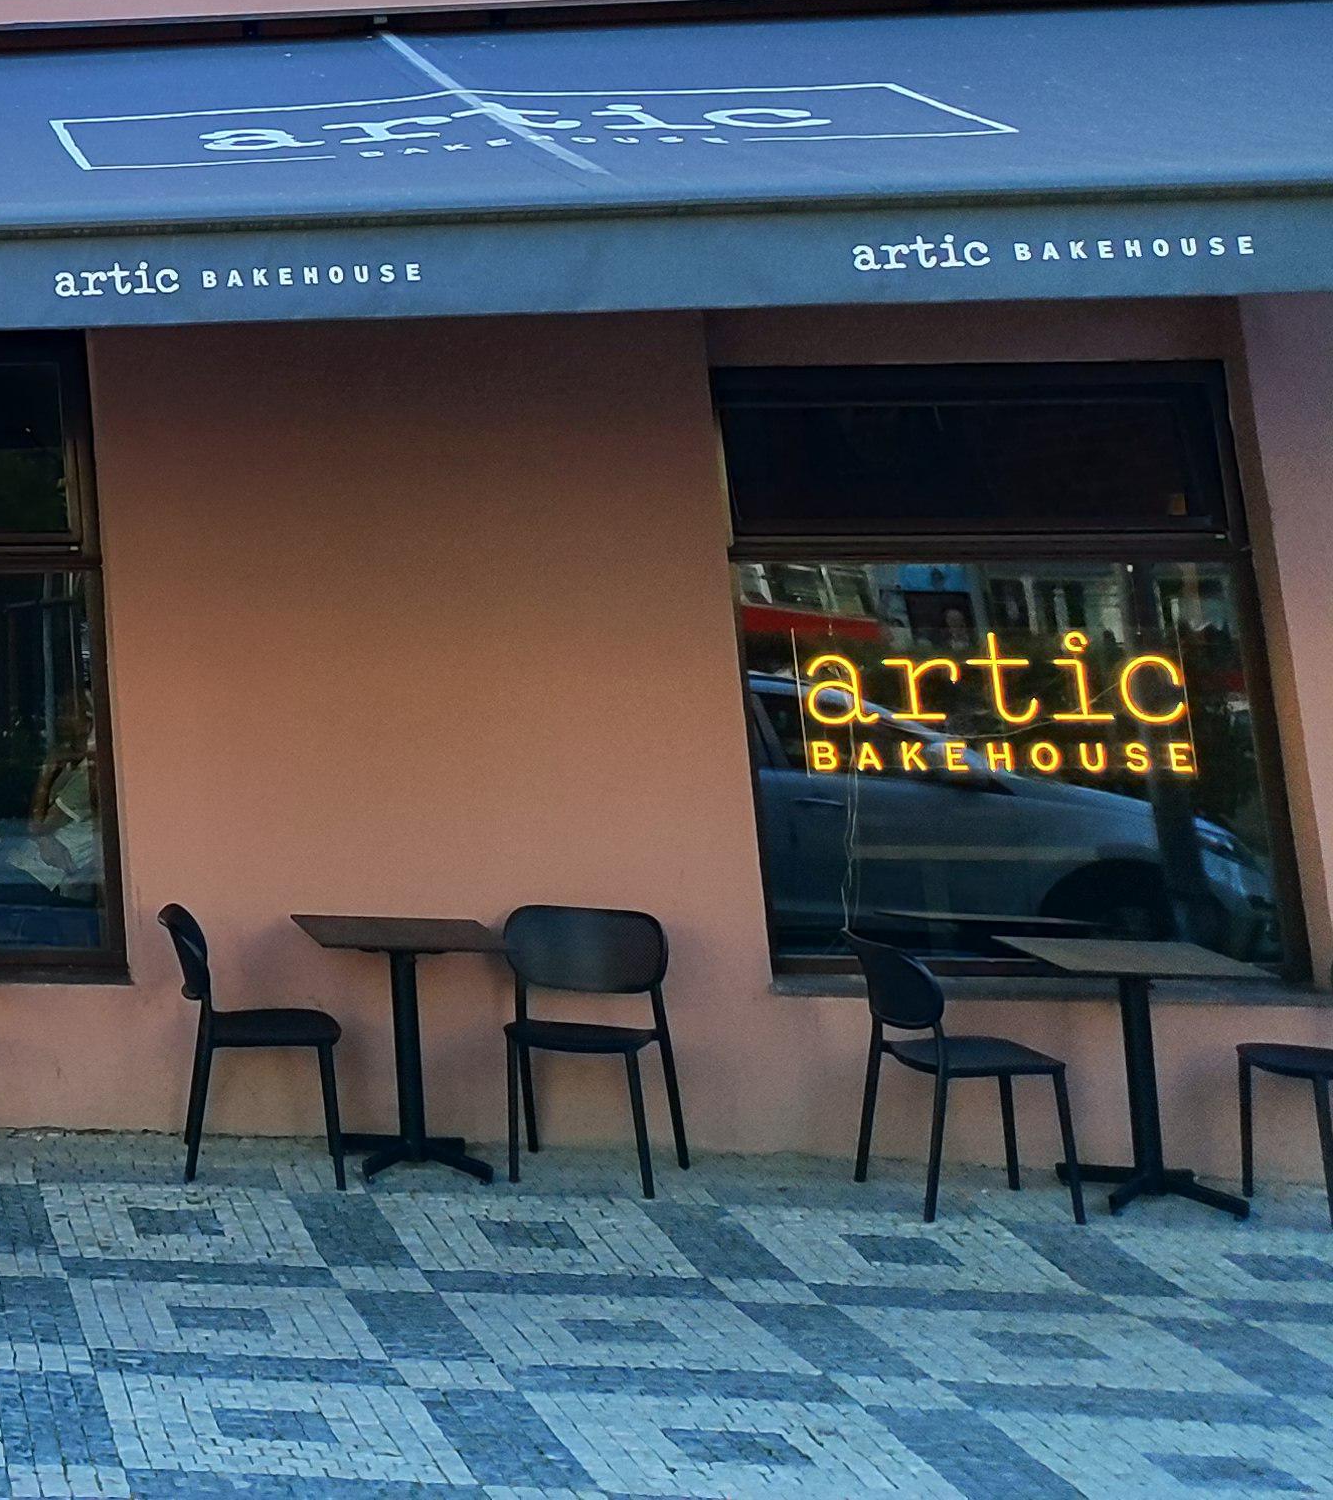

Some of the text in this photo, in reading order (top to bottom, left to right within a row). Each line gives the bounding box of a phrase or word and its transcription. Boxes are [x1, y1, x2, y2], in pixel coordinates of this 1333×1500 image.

[199, 103, 832, 151] artic
[852, 234, 1254, 271] artic BAKEHOUSE
[55, 261, 421, 297] artic BAKEHOUSE
[806, 630, 1187, 725] artic
[810, 740, 1196, 774] BAKEHOUSE
